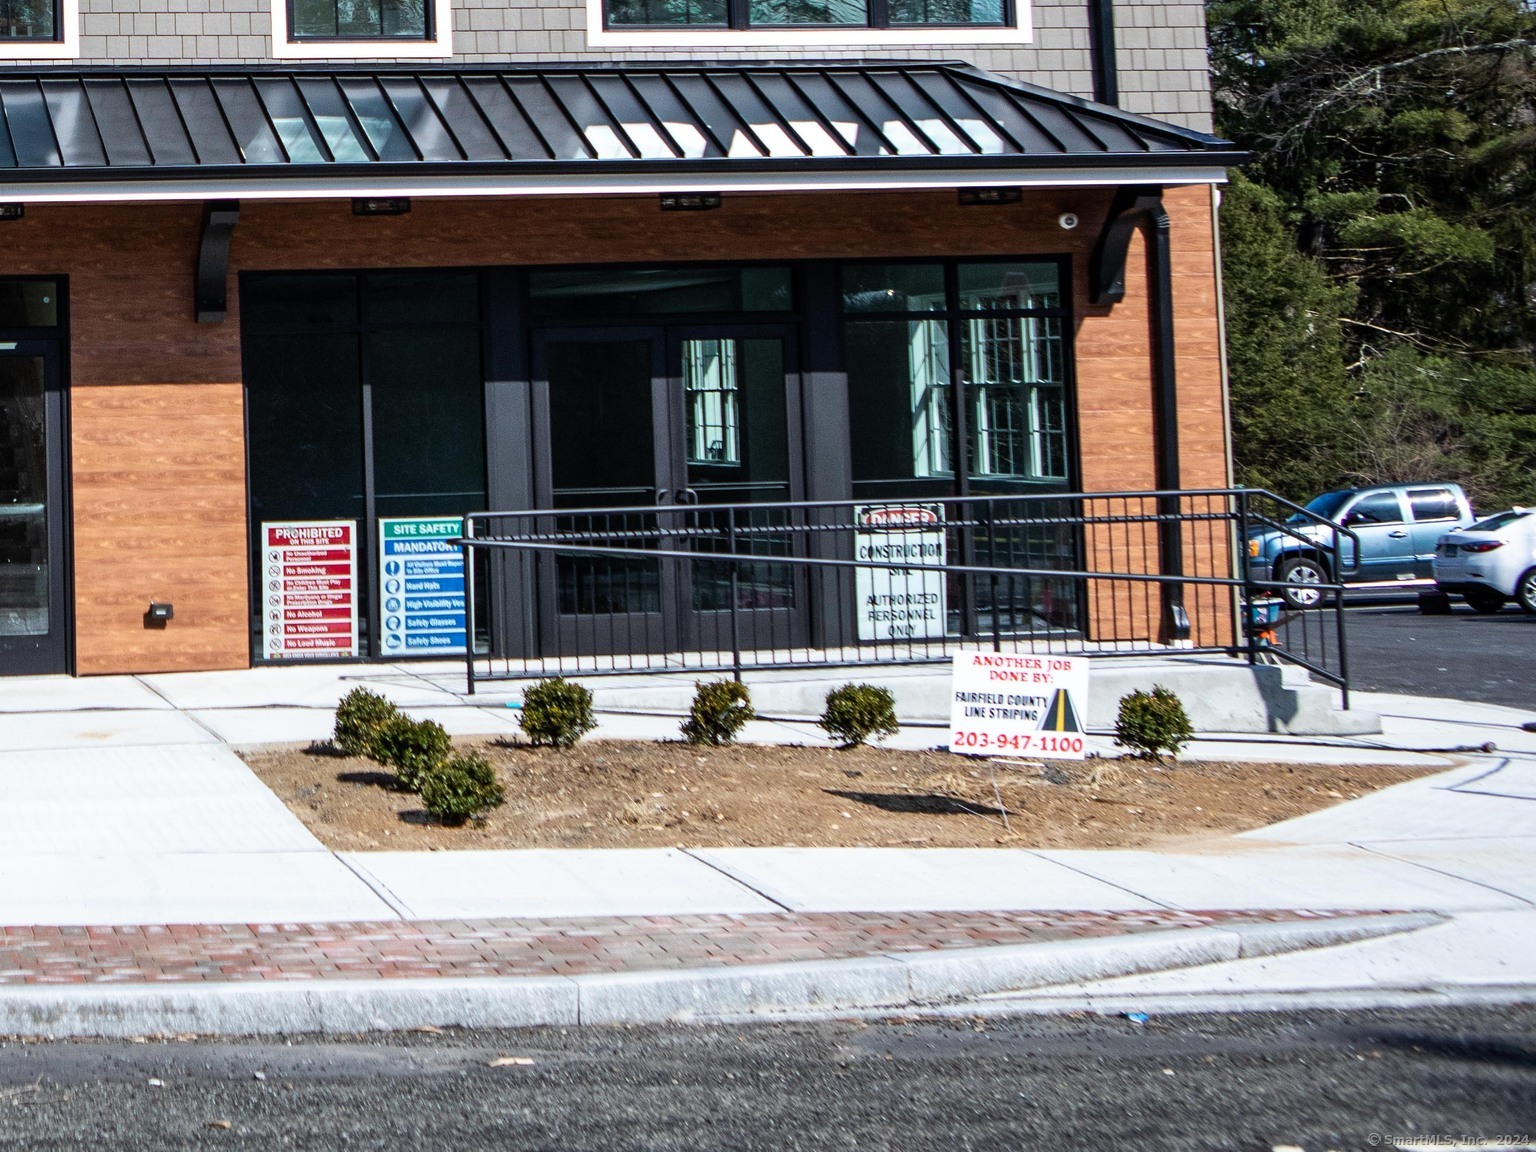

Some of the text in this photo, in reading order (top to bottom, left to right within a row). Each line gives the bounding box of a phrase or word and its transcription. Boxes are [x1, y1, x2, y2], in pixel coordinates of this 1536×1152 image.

[275, 528, 343, 539] PROHIBITED
[393, 523, 459, 535] SITE SAFETY
[860, 543, 942, 559] CONSTRUCTION
[296, 566, 326, 575] Smoking
[406, 581, 440, 590] Hard Hats
[406, 600, 423, 610] High
[423, 599, 452, 609] Visibility
[866, 593, 938, 606] AUTHORIZED
[297, 610, 323, 618] Alcohol
[868, 608, 936, 622] PERSONNEL
[407, 617, 457, 628] Safety Glasses
[286, 625, 328, 634] No Weapons
[888, 624, 916, 636] ONLY
[297, 639, 314, 647] Loud
[315, 639, 336, 647] Music
[407, 636, 451, 646] Safety Shoes
[973, 655, 1072, 671] ANOTHER JOB
[989, 670, 1054, 684] DONE BY:
[955, 691, 1049, 708] FAIRFIELD COUNTY
[964, 706, 1038, 721] LINE STRIPING
[954, 731, 1083, 753] 203-947-1100
